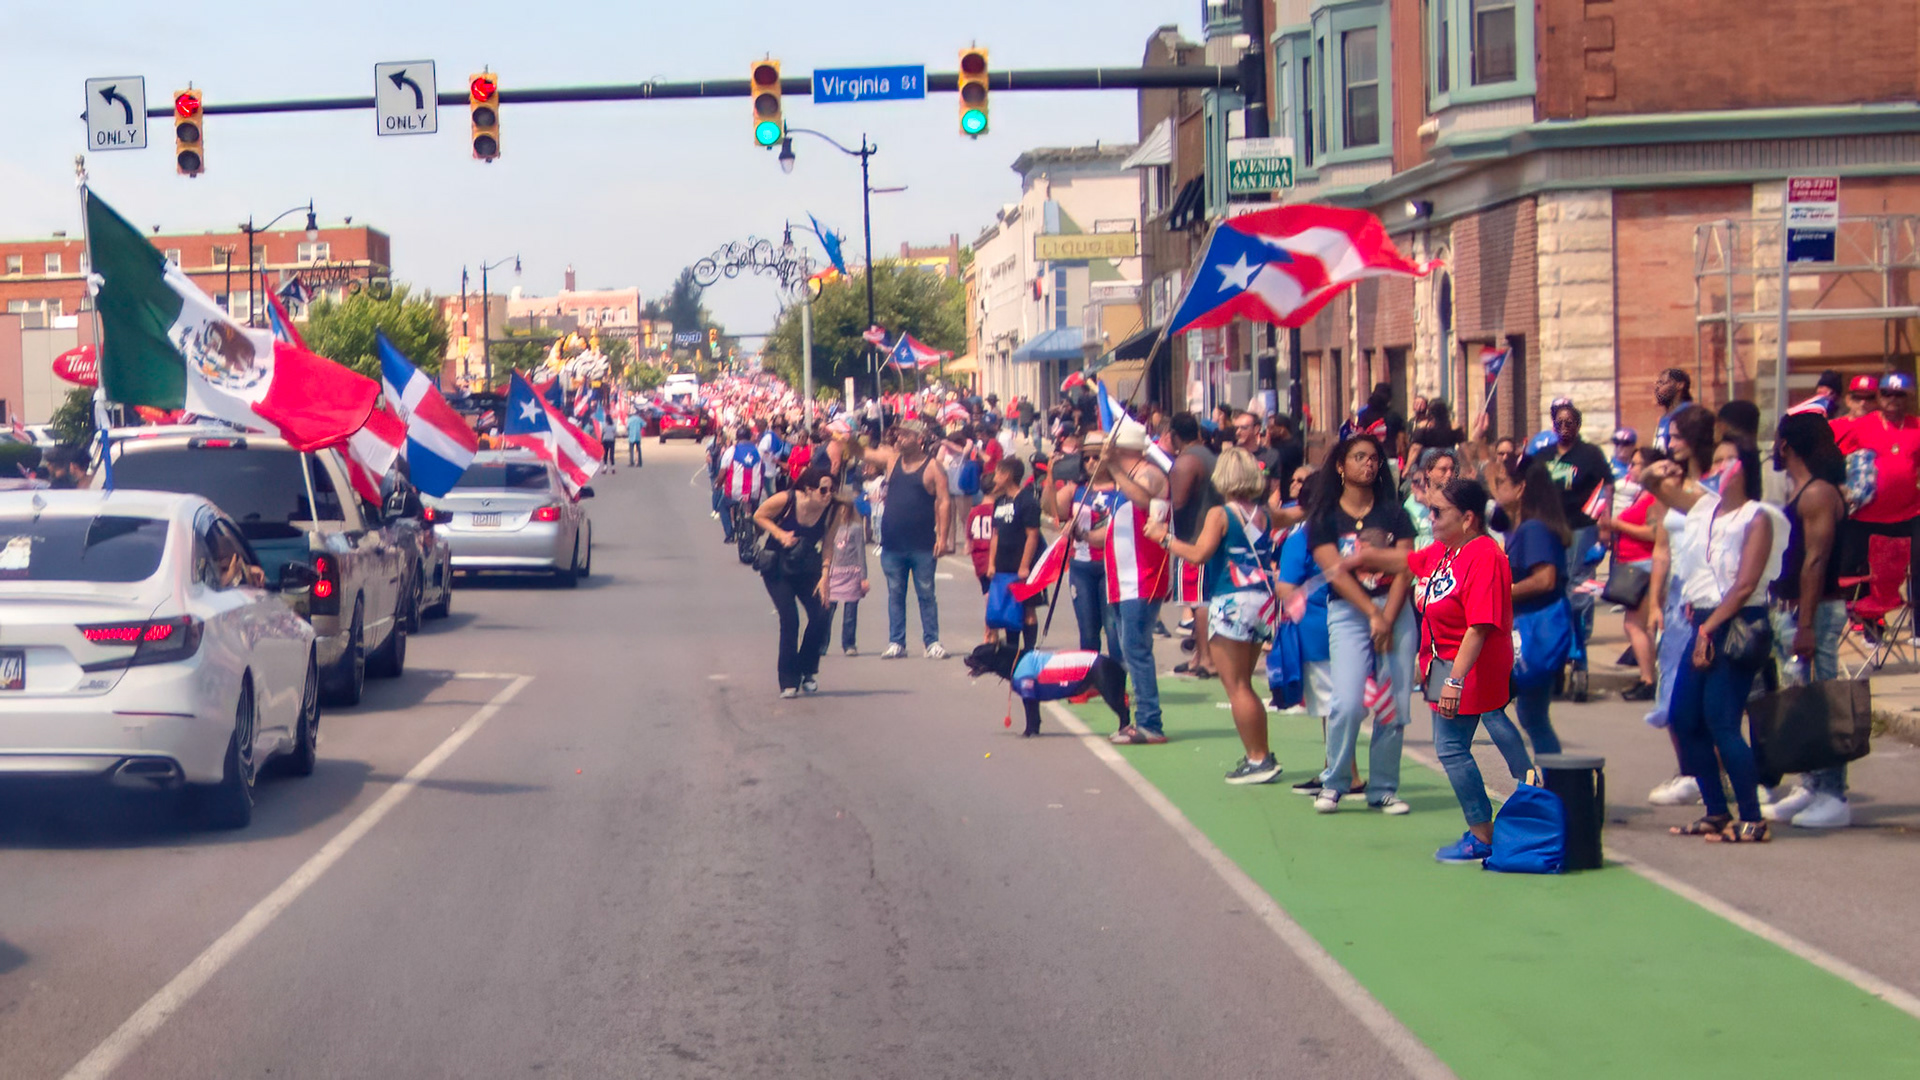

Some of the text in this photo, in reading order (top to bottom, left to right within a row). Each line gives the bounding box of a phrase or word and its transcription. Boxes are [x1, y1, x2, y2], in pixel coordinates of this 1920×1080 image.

[822, 75, 917, 100] Virginia St
[386, 114, 427, 130] ONLY
[97, 130, 137, 146] ONLY
[1234, 158, 1288, 173] AVENIDA
[1233, 173, 1290, 189] SAN JUAN
[1043, 240, 1129, 255] LIQUORS
[971, 515, 993, 540] 40
